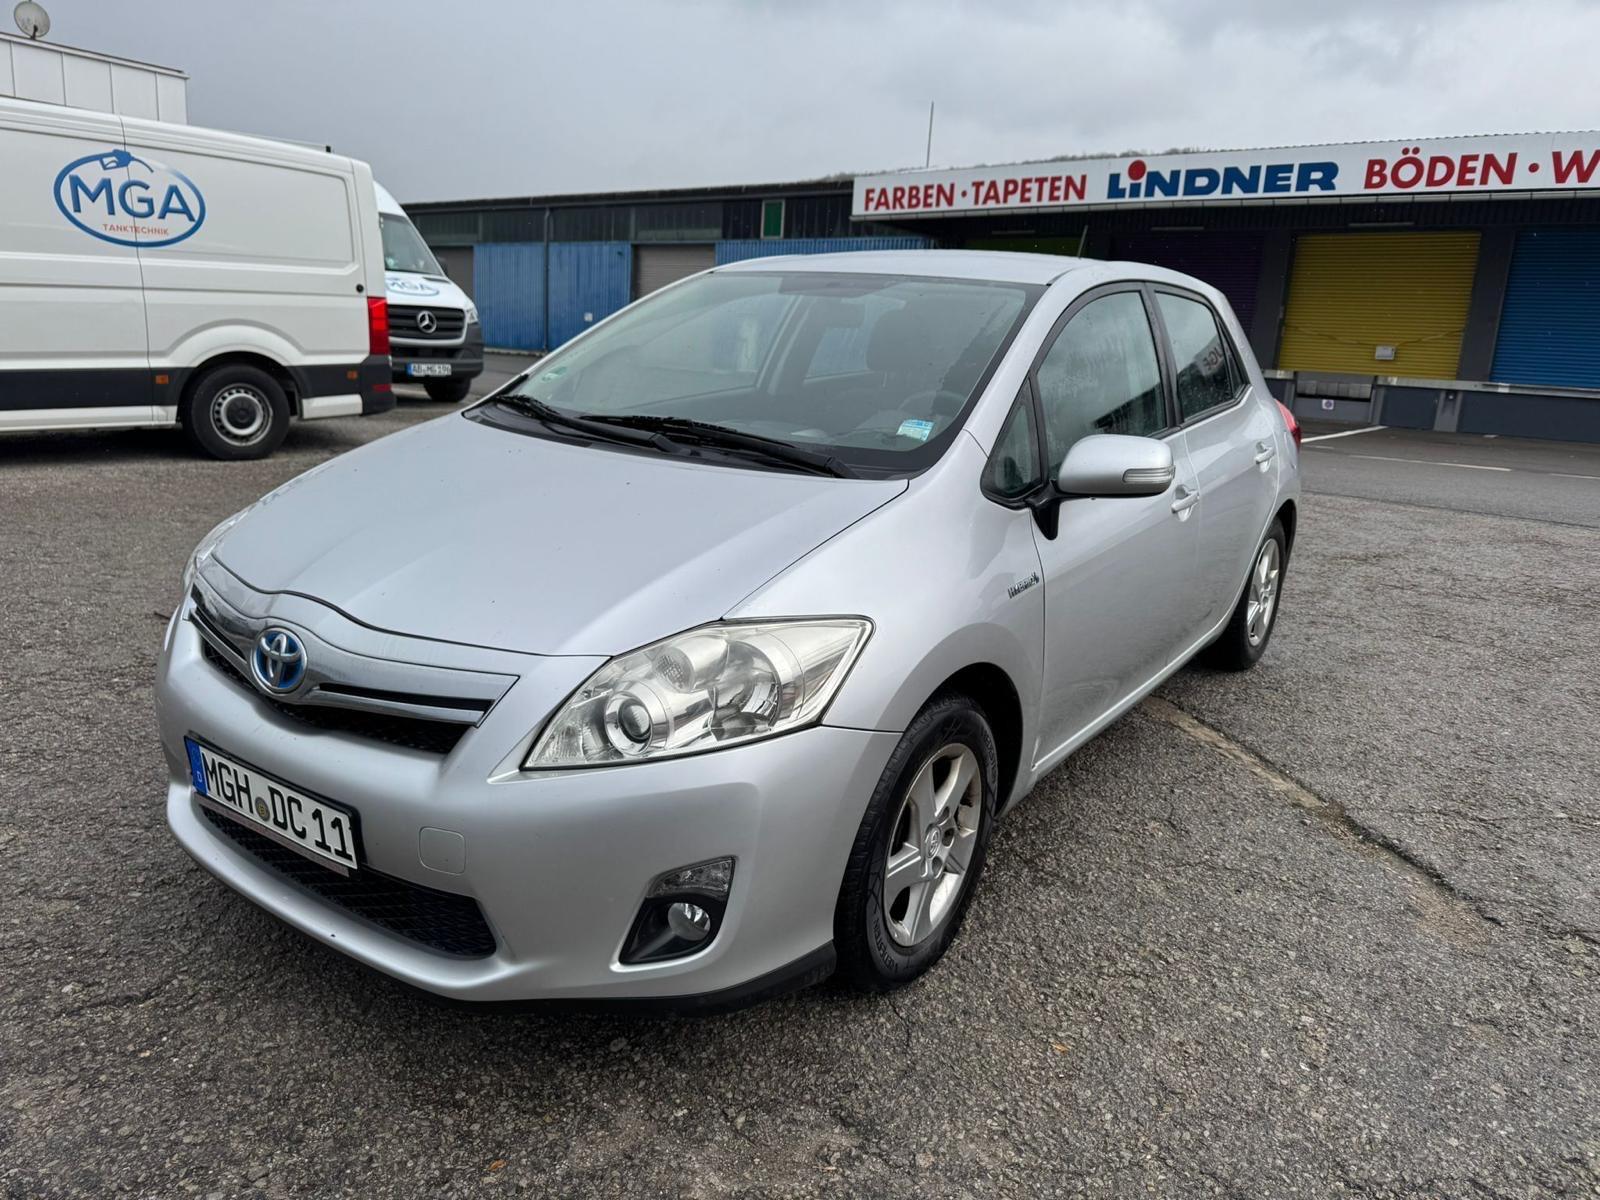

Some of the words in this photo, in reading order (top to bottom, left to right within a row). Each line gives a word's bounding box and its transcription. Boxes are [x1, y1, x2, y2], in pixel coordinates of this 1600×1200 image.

[69, 174, 196, 222] MGA
[864, 182, 955, 212] FARBEN
[971, 174, 1087, 206] TAPETEN
[1364, 146, 1518, 189] BÖDEN
[102, 223, 169, 236] TANKTECHNIK
[202, 752, 254, 814] MGH
[268, 785, 307, 840] DC
[311, 808, 353, 862] 11
